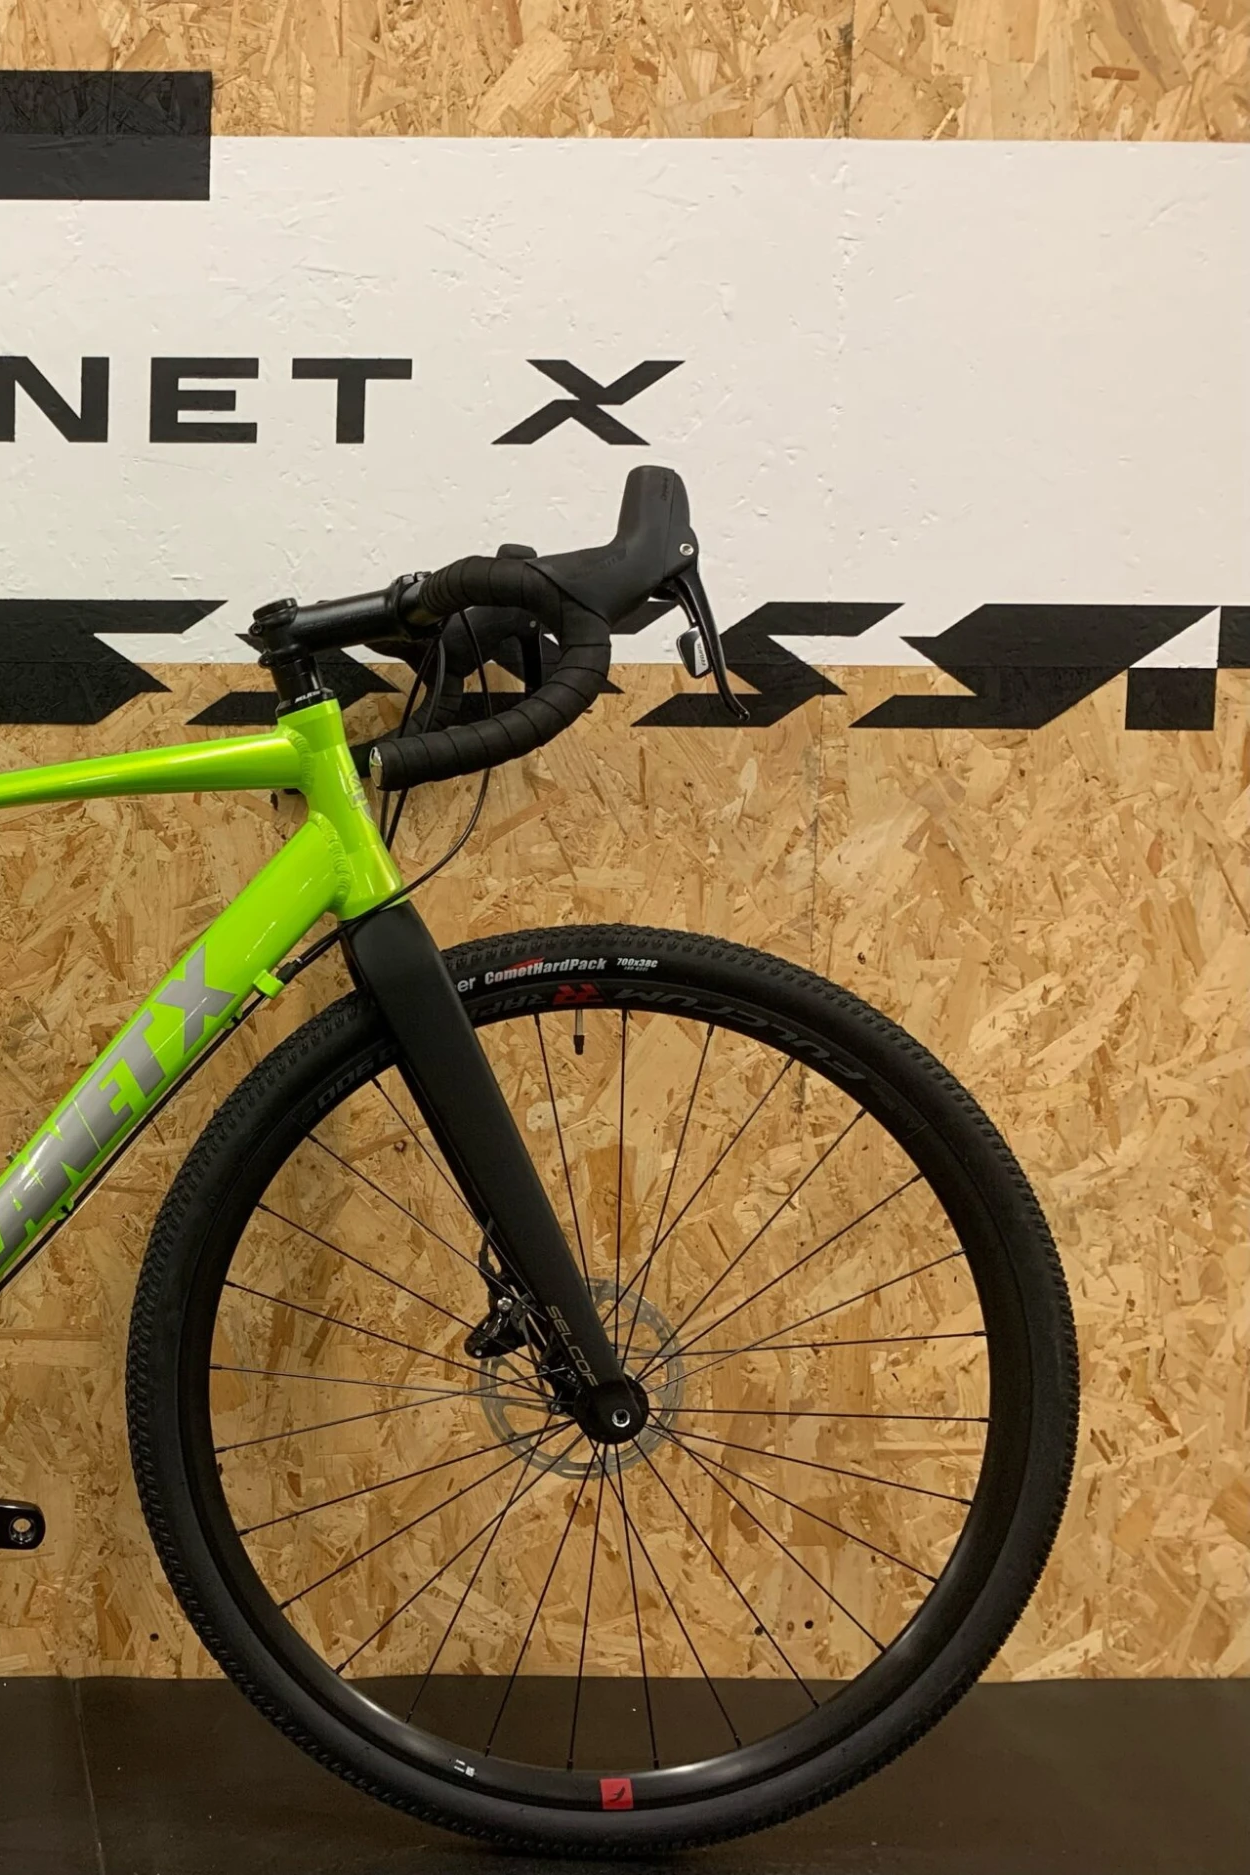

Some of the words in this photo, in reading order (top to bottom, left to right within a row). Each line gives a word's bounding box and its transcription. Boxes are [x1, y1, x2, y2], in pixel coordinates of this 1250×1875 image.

[491, 360, 684, 445] X
[156, 942, 238, 1055] X
[484, 958, 608, 985] CometHardPack
[614, 988, 866, 1080] FULCRUM
[545, 1305, 599, 1387] SELCOF
